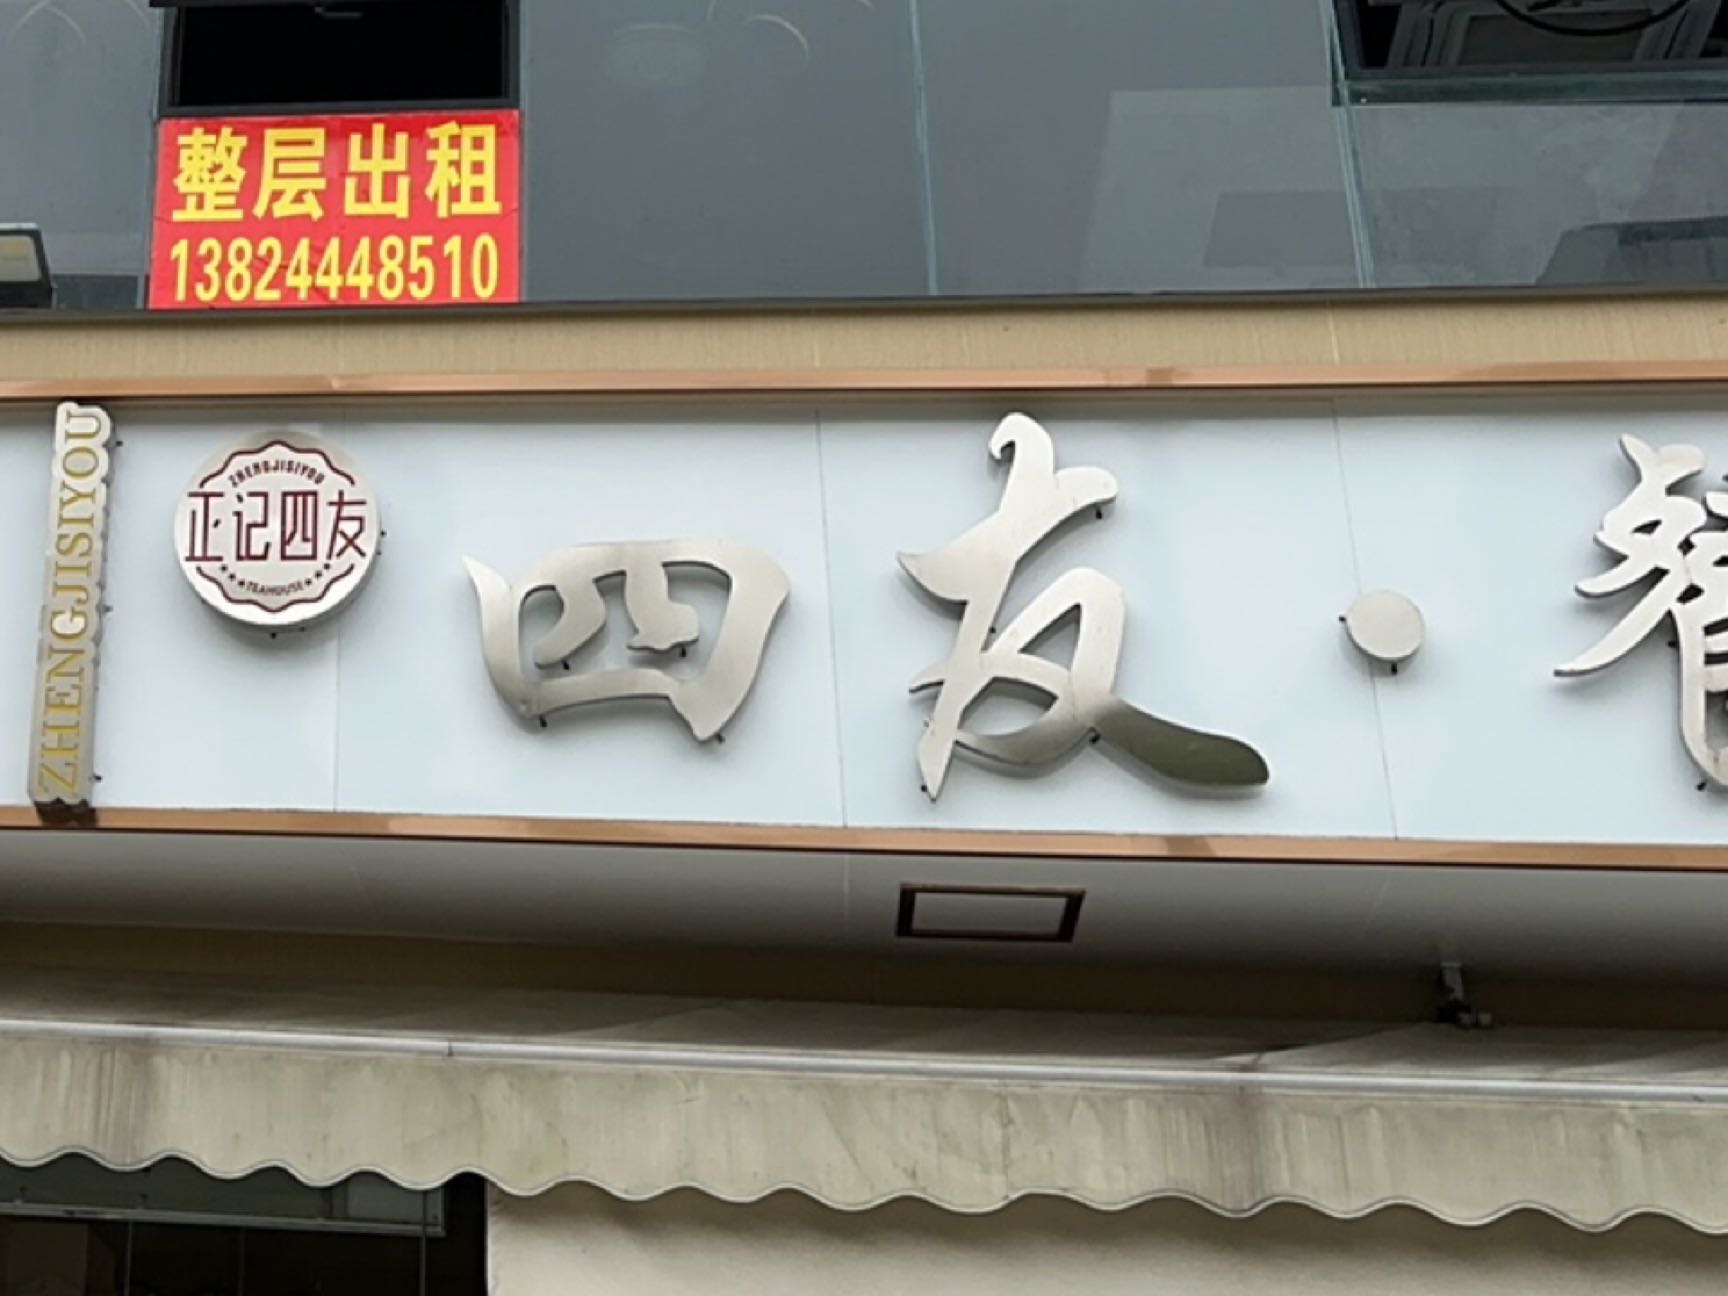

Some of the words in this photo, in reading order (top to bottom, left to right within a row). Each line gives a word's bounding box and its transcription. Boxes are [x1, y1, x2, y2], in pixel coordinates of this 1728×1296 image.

[172, 121, 502, 221] 整层出租
[170, 233, 499, 301] 13824448510
[184, 489, 368, 562] 正记四友
[38, 409, 103, 795] ZHENGJISIYOU
